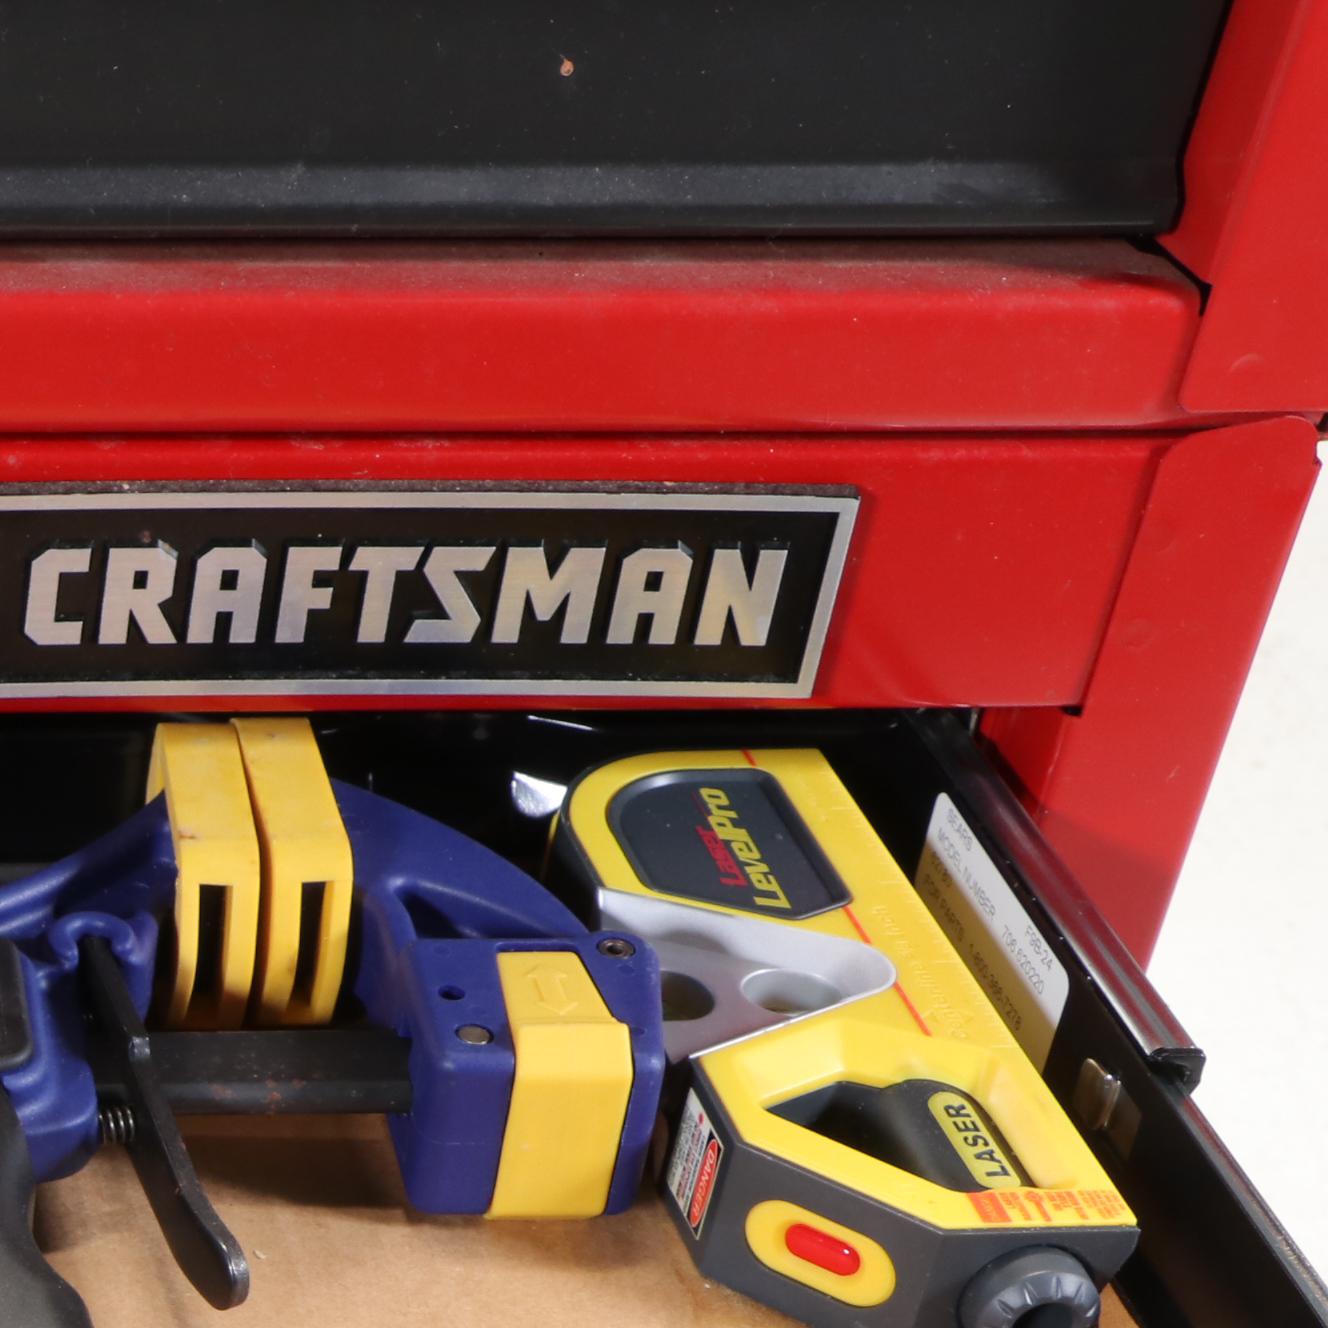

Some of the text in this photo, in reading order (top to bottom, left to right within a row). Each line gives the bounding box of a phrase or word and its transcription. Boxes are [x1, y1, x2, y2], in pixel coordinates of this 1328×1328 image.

[21, 541, 790, 646] CRAFTSMAN
[695, 825, 748, 886] Laser
[699, 787, 792, 909] LevelPro
[946, 808, 973, 852] SEARS
[936, 827, 962, 874] MODEL
[961, 866, 997, 919] NUMBER
[944, 1103, 1012, 1177] LASER
[691, 1150, 715, 1217] DANGER
